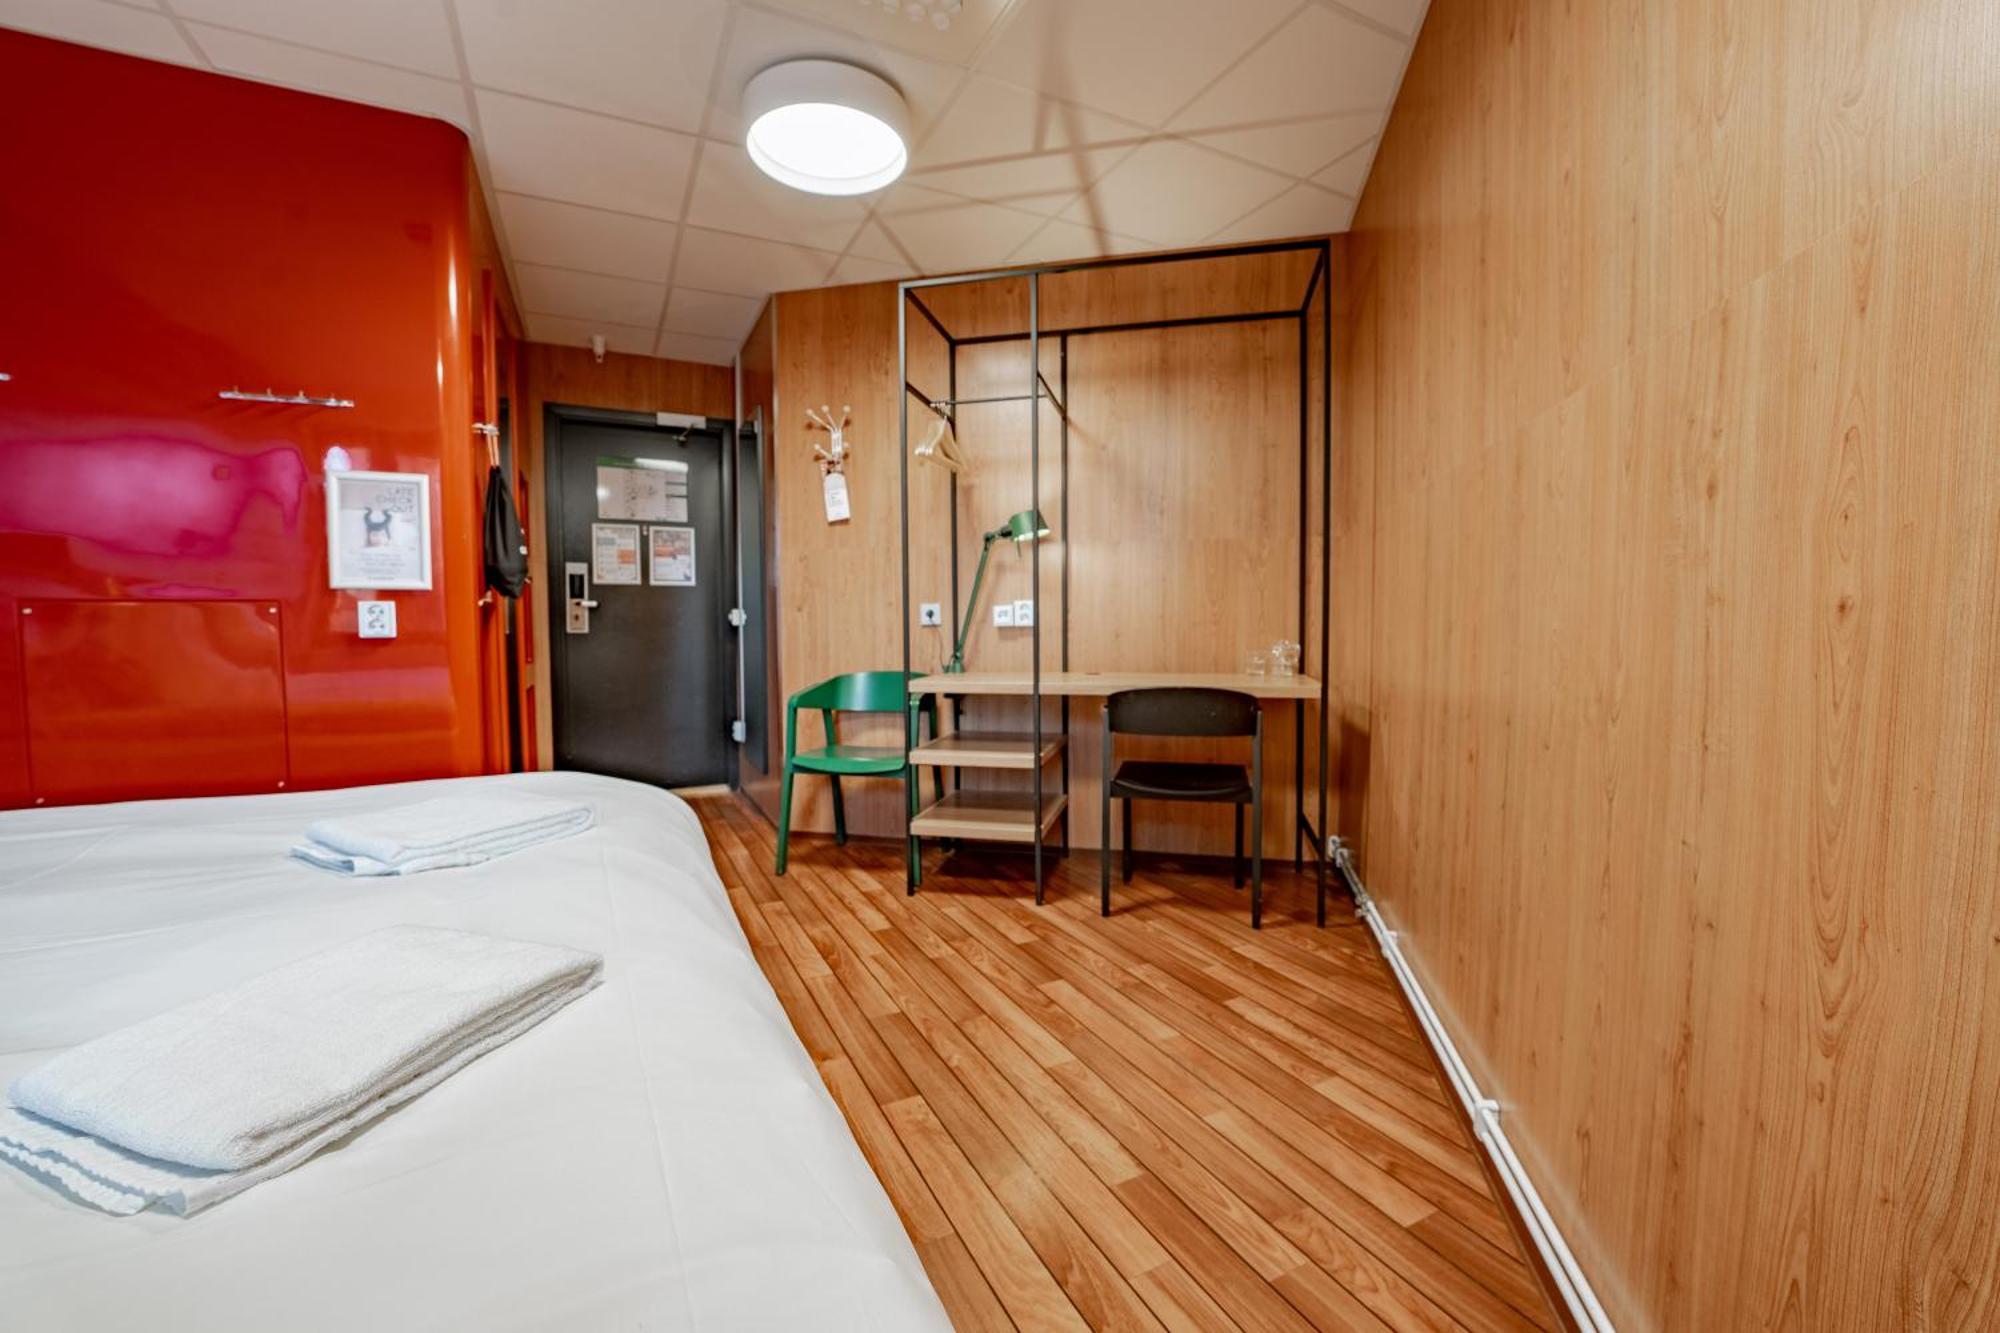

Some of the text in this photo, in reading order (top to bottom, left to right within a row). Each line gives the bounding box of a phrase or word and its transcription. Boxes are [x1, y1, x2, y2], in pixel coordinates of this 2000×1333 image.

[387, 487, 415, 496] LATE
[376, 496, 413, 504] CHECK
[392, 504, 414, 513] OUT
